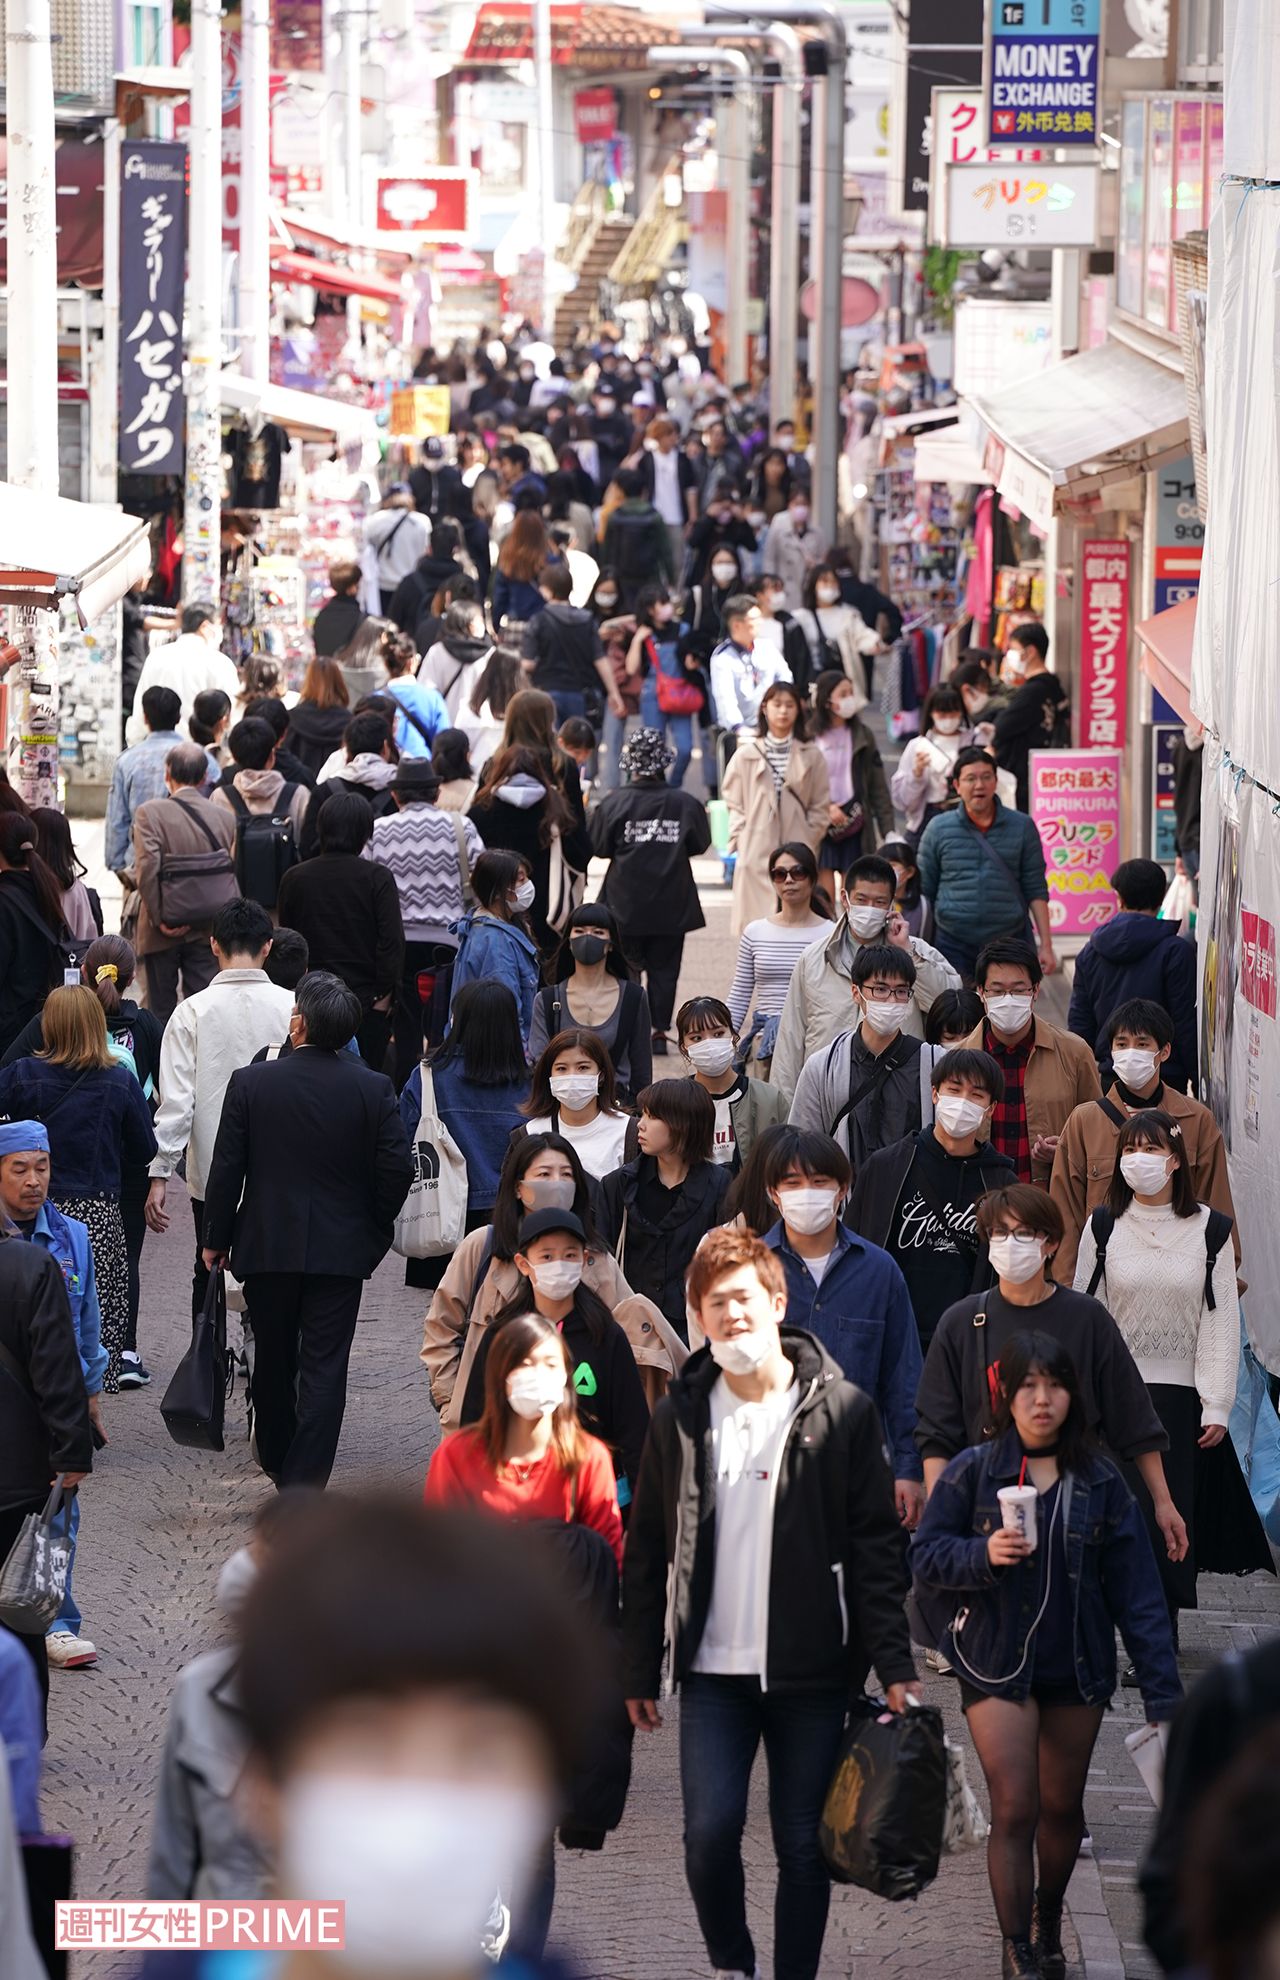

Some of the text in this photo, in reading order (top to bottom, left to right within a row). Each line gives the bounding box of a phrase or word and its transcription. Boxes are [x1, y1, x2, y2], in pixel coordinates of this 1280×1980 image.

[994, 44, 1094, 77] MONEY
[993, 82, 1095, 106] EXCHANGE
[1016, 111, 1094, 133] 外币兑换
[141, 193, 173, 302] ギャラリー
[125, 309, 182, 469] ハセガワ
[1039, 769, 1115, 791] 都内最大
[1036, 797, 1118, 811] PURIKURA
[1040, 818, 1115, 842] プリクラ
[1053, 848, 1101, 866] ランド
[1047, 871, 1112, 893] NOA
[1080, 904, 1113, 922] ノア
